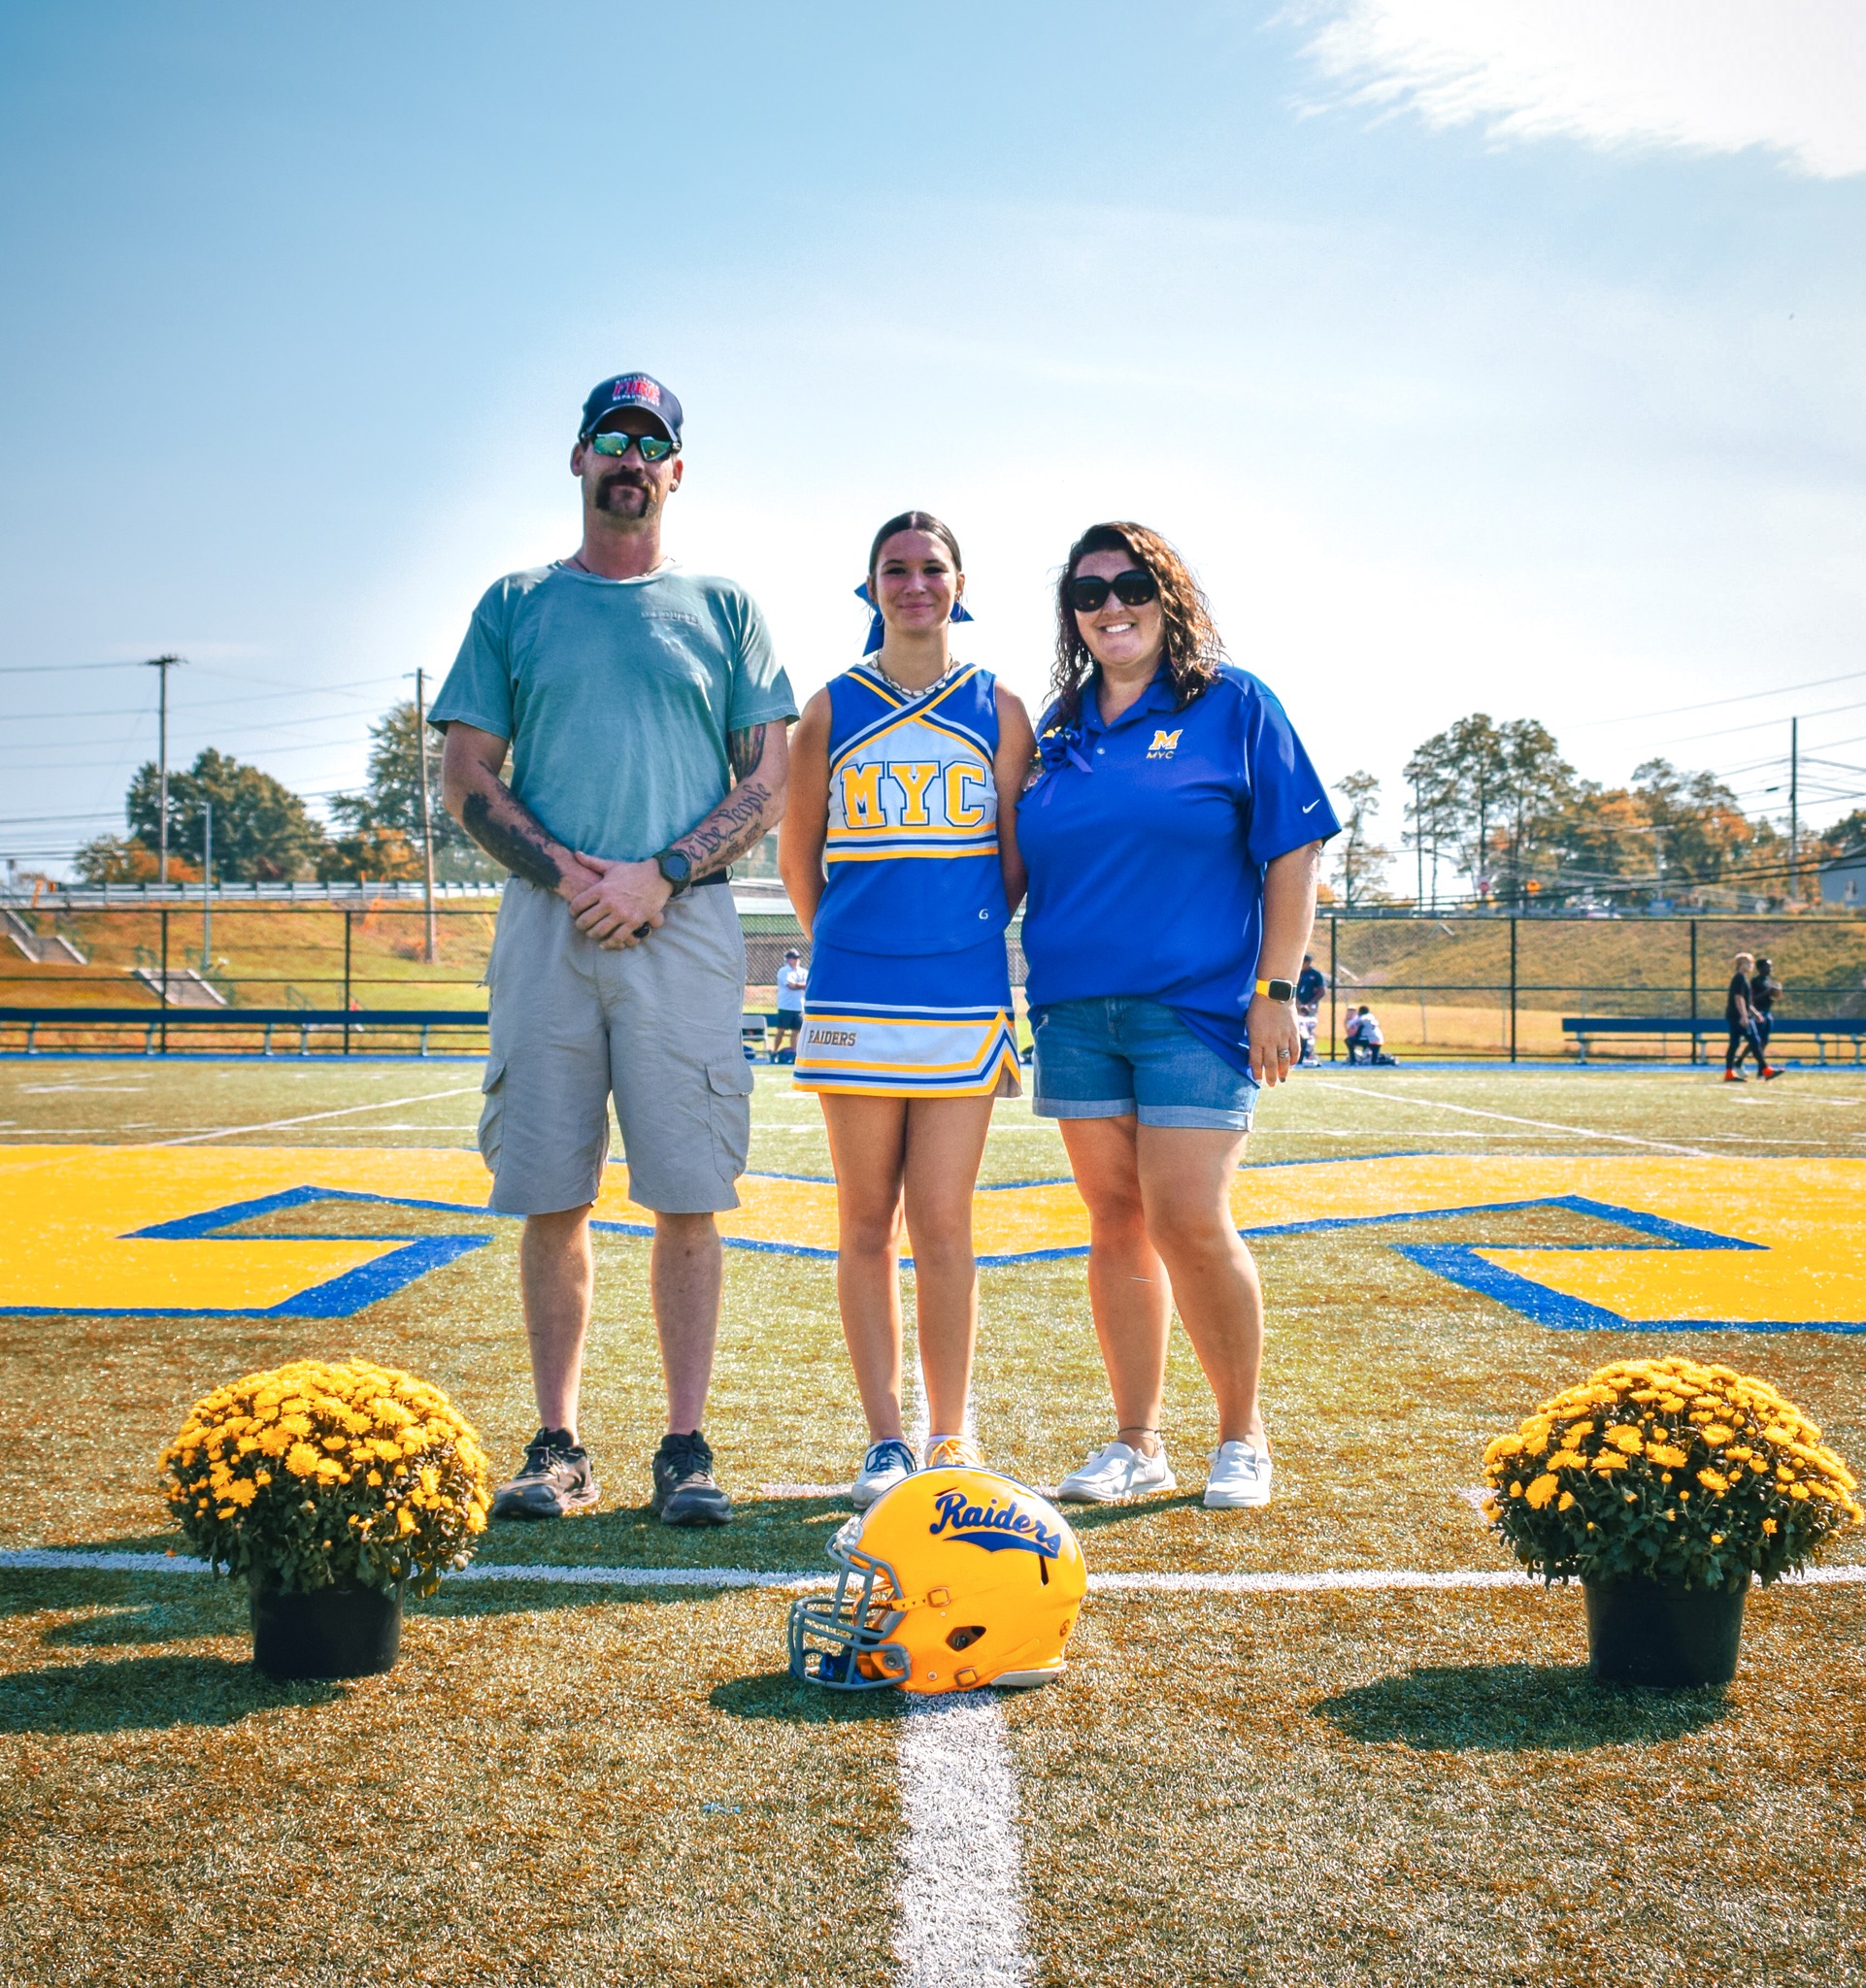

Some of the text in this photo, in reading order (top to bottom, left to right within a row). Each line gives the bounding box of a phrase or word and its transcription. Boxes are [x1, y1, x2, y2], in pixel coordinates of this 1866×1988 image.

[613, 381, 660, 402] FIRE
[1148, 728, 1183, 751] M
[1146, 750, 1175, 760] MYC
[840, 760, 987, 830] MYC
[711, 783, 771, 842] People
[807, 1029, 857, 1046] RAIDERS
[929, 1492, 1062, 1556] Raiders
